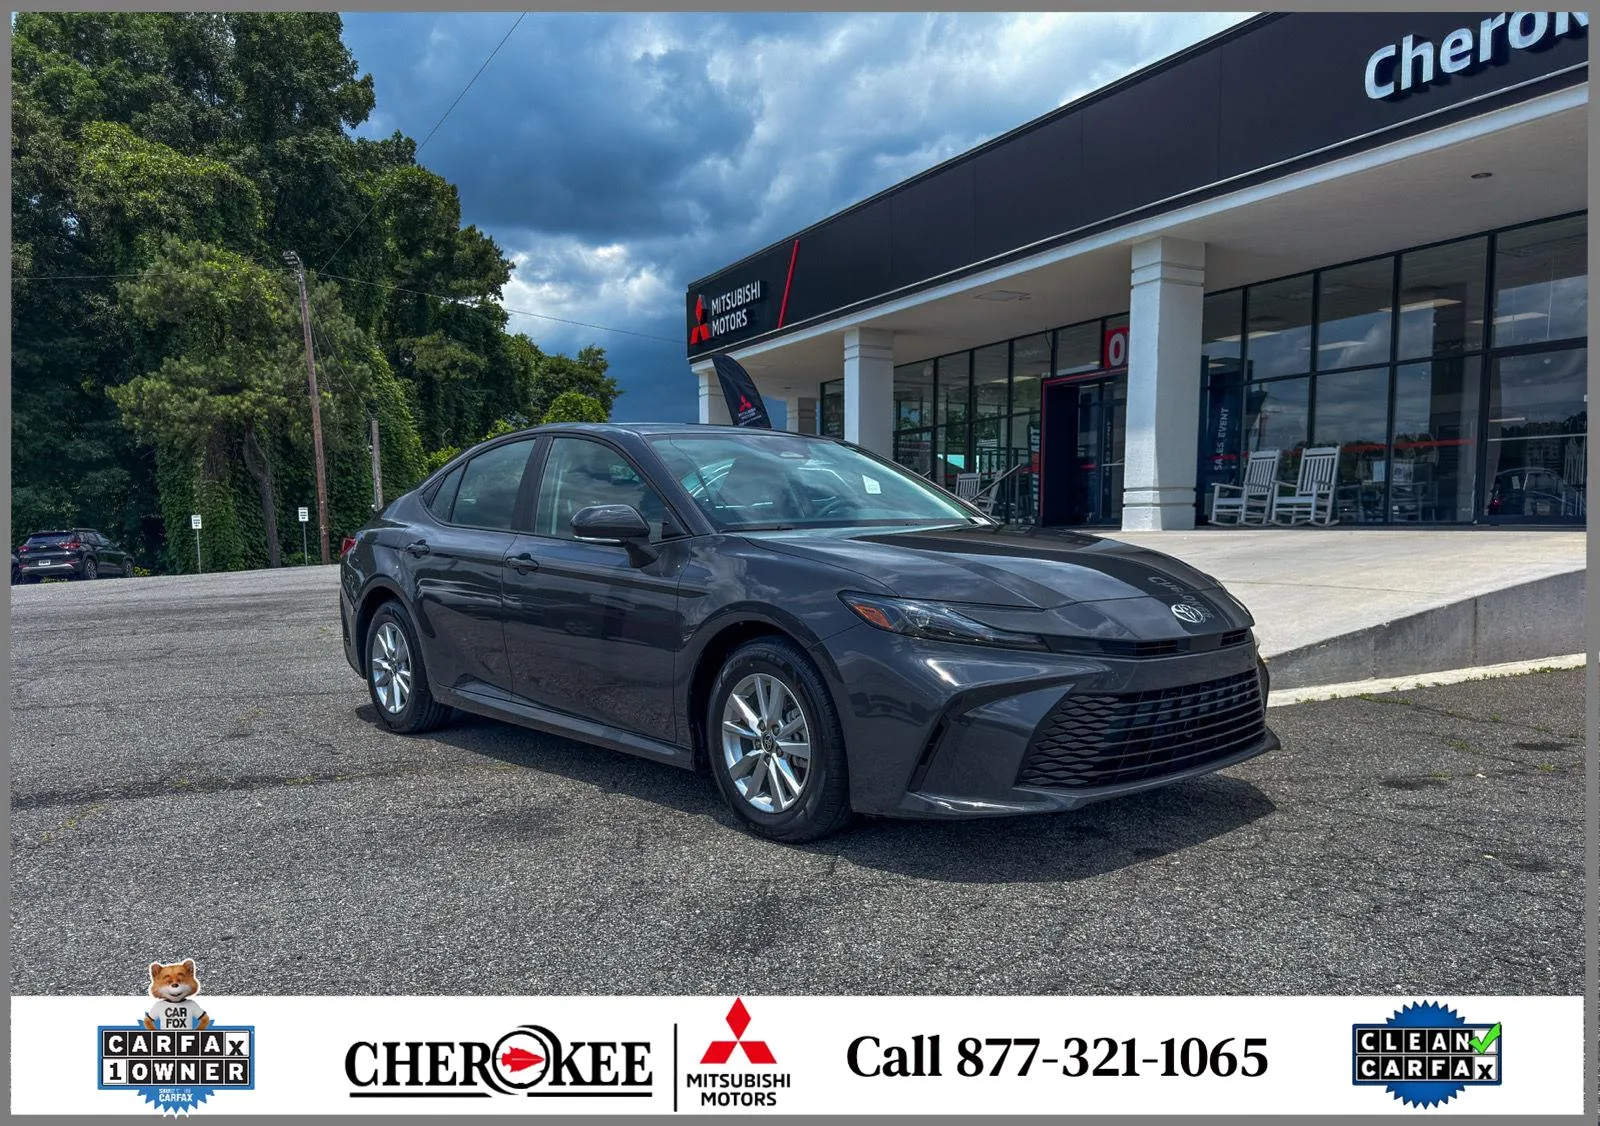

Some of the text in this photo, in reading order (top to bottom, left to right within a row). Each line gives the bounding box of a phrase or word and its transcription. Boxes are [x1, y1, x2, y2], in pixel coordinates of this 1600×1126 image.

[711, 280, 761, 316] MITSUBISHI
[712, 309, 748, 337] MOTORS
[1109, 333, 1129, 367] O
